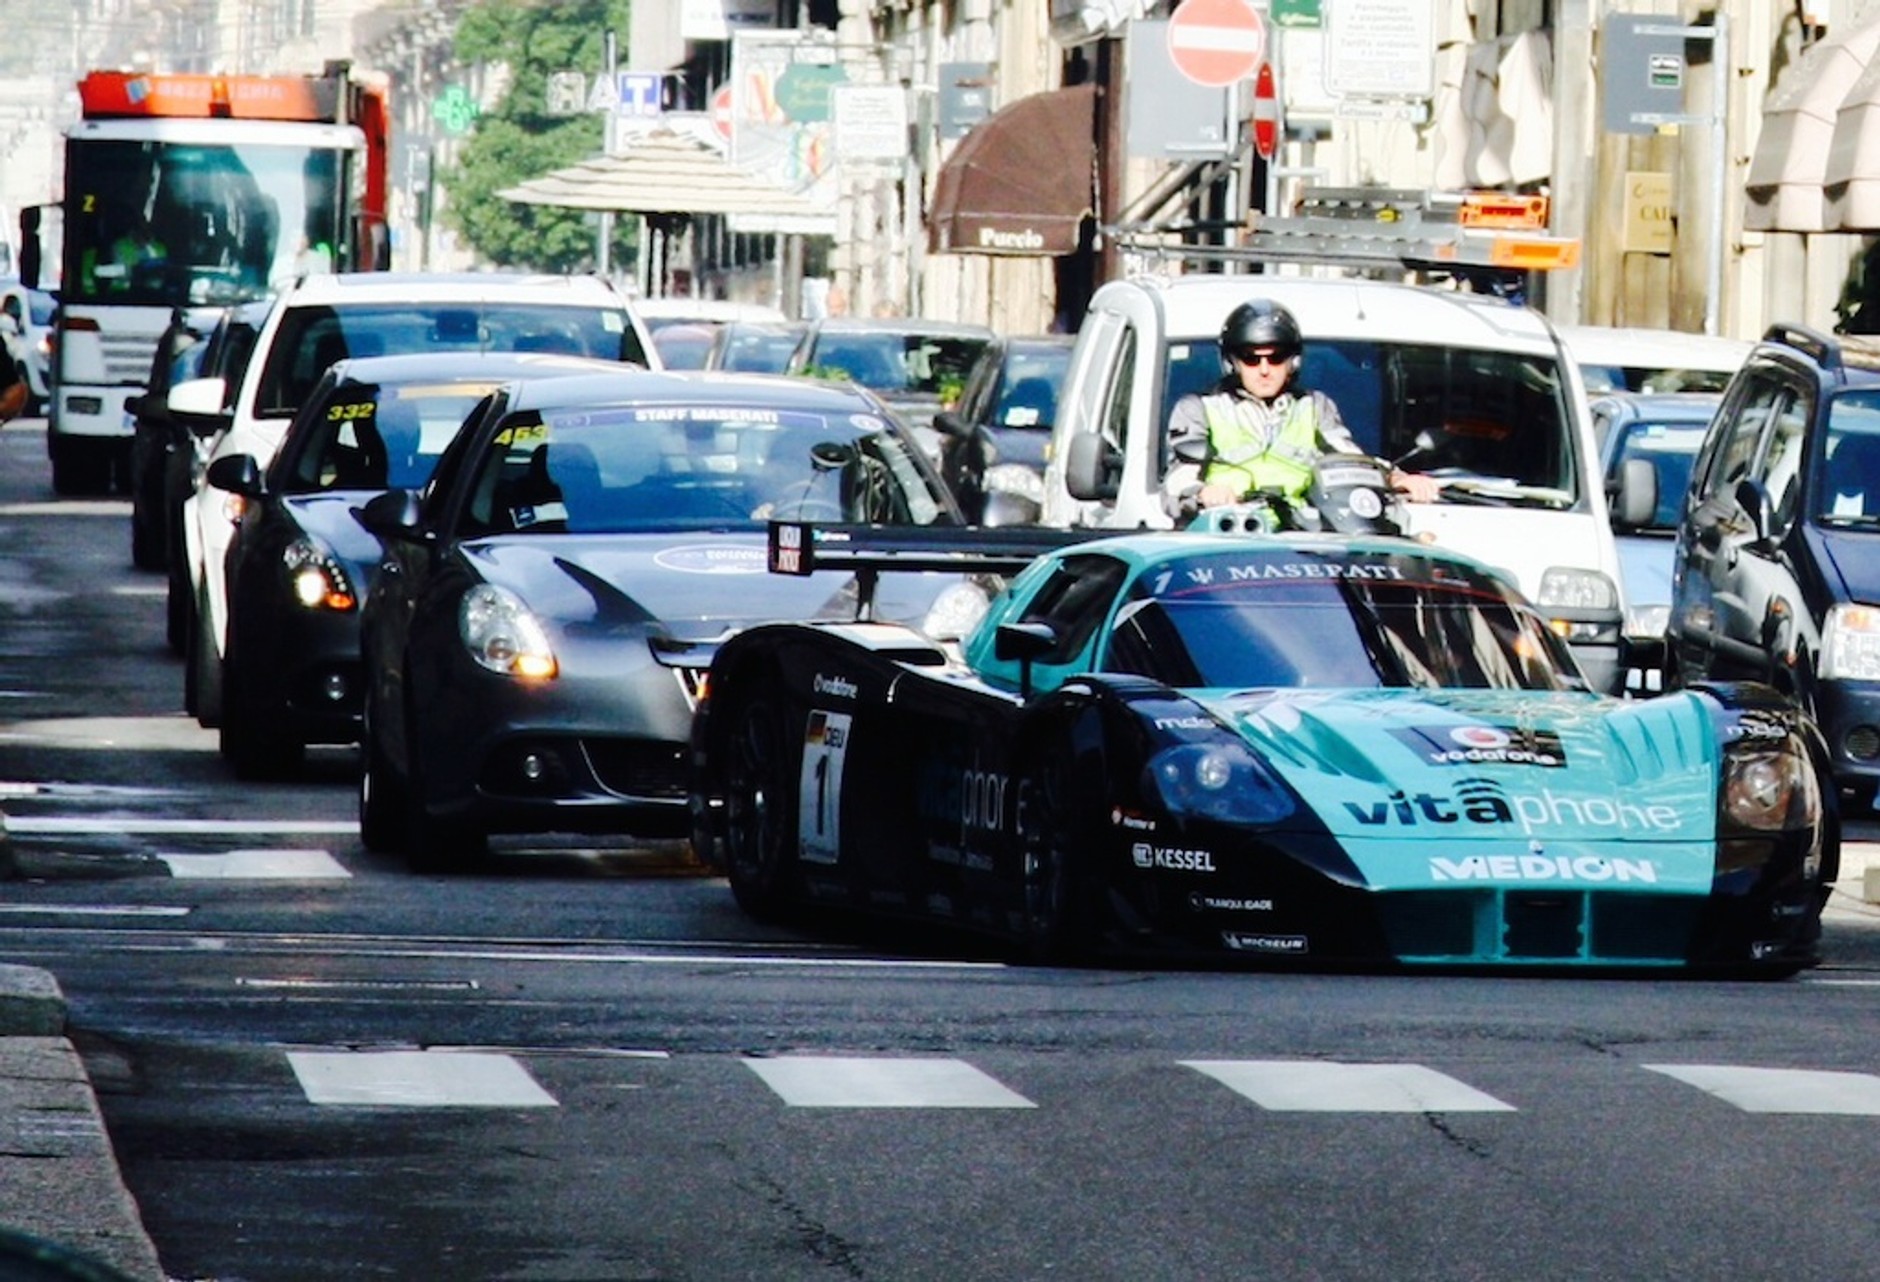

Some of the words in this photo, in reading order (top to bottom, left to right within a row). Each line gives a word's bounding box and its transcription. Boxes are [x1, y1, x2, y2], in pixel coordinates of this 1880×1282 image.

[327, 402, 375, 421] 332
[635, 409, 689, 422] STAFF
[691, 407, 779, 424] MASERATI
[1228, 562, 1406, 581] MASERATI
[1429, 748, 1559, 766] vodafone
[815, 754, 828, 837] 1
[1342, 784, 1684, 836] vitaphone
[1155, 849, 1217, 872] KESSEL
[1429, 855, 1658, 884] MEDION
